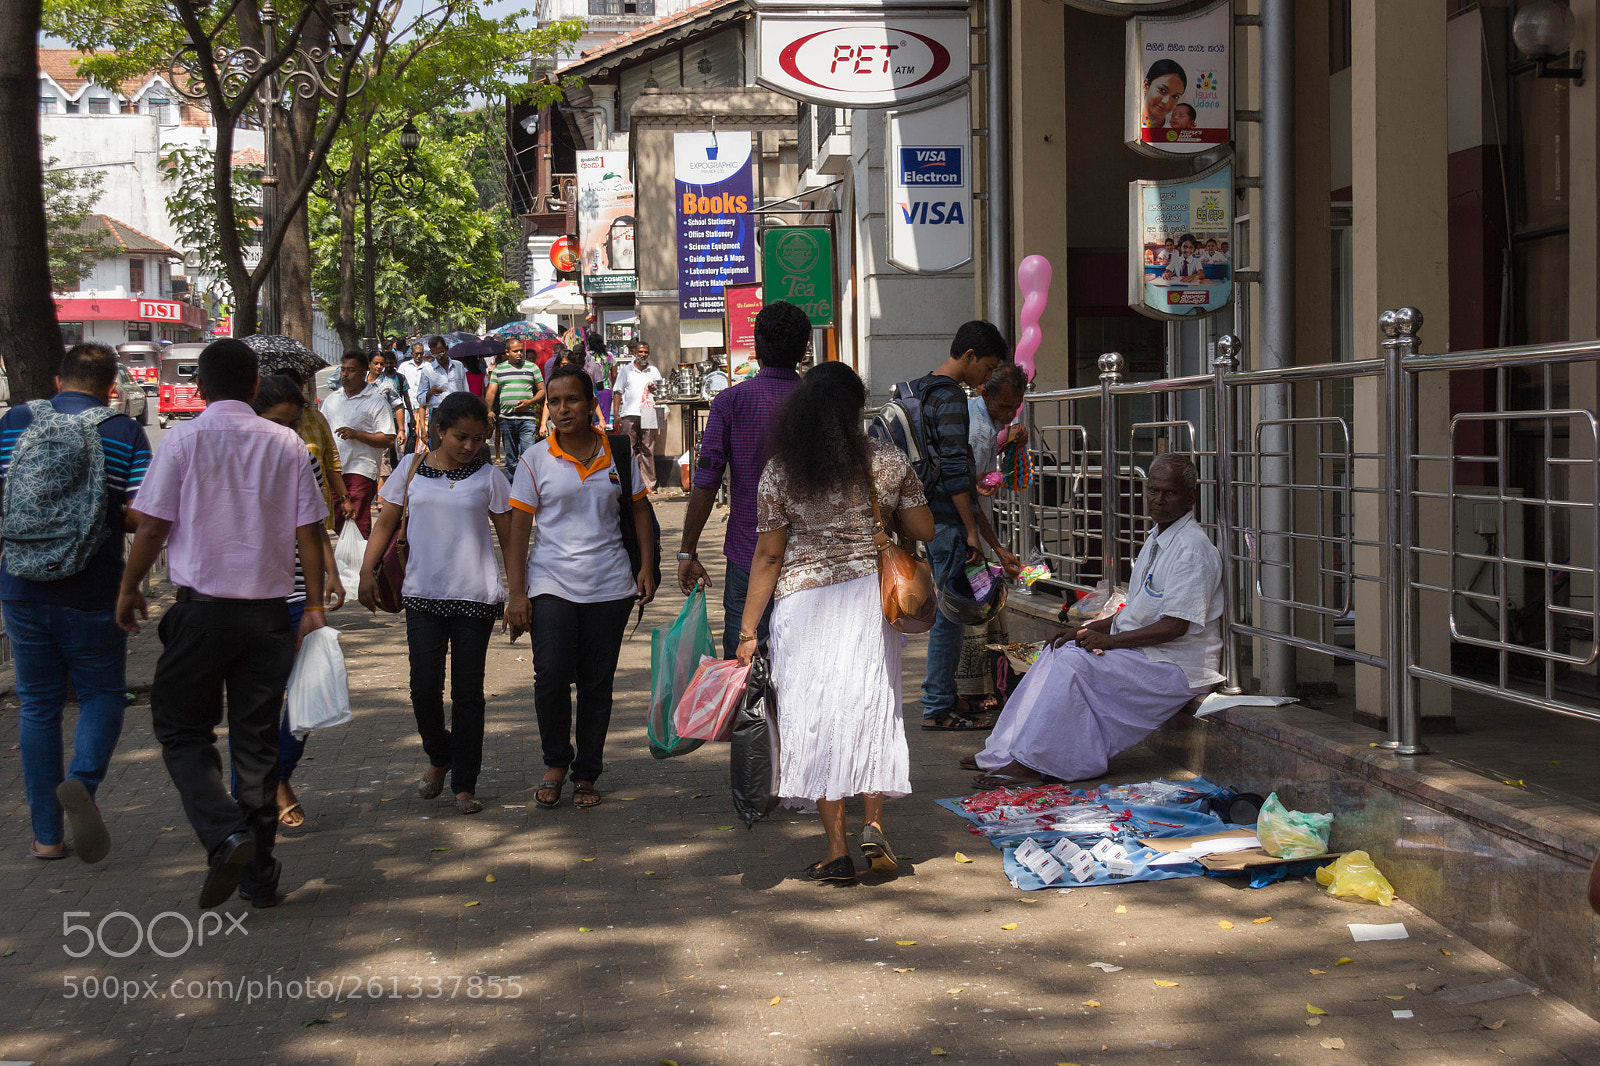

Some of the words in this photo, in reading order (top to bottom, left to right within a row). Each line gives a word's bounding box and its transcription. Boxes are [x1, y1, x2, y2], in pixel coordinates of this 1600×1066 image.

[830, 45, 900, 74] PET
[894, 66, 915, 75] ATM
[916, 151, 946, 161] VISA
[689, 161, 738, 170] EXPOGRAPHIC
[904, 171, 957, 182] Electron
[683, 192, 748, 214] Books
[896, 202, 964, 224] VISA
[688, 218, 706, 226] School
[708, 218, 735, 226] Stationery
[706, 230, 733, 238] Stationery
[711, 242, 740, 251] Equipment
[730, 255, 745, 263] Maps
[690, 267, 719, 275] Laboratory
[720, 266, 749, 275] Equipment
[710, 279, 733, 287] Material
[782, 275, 815, 297] Tea
[144, 304, 175, 318] DSI
